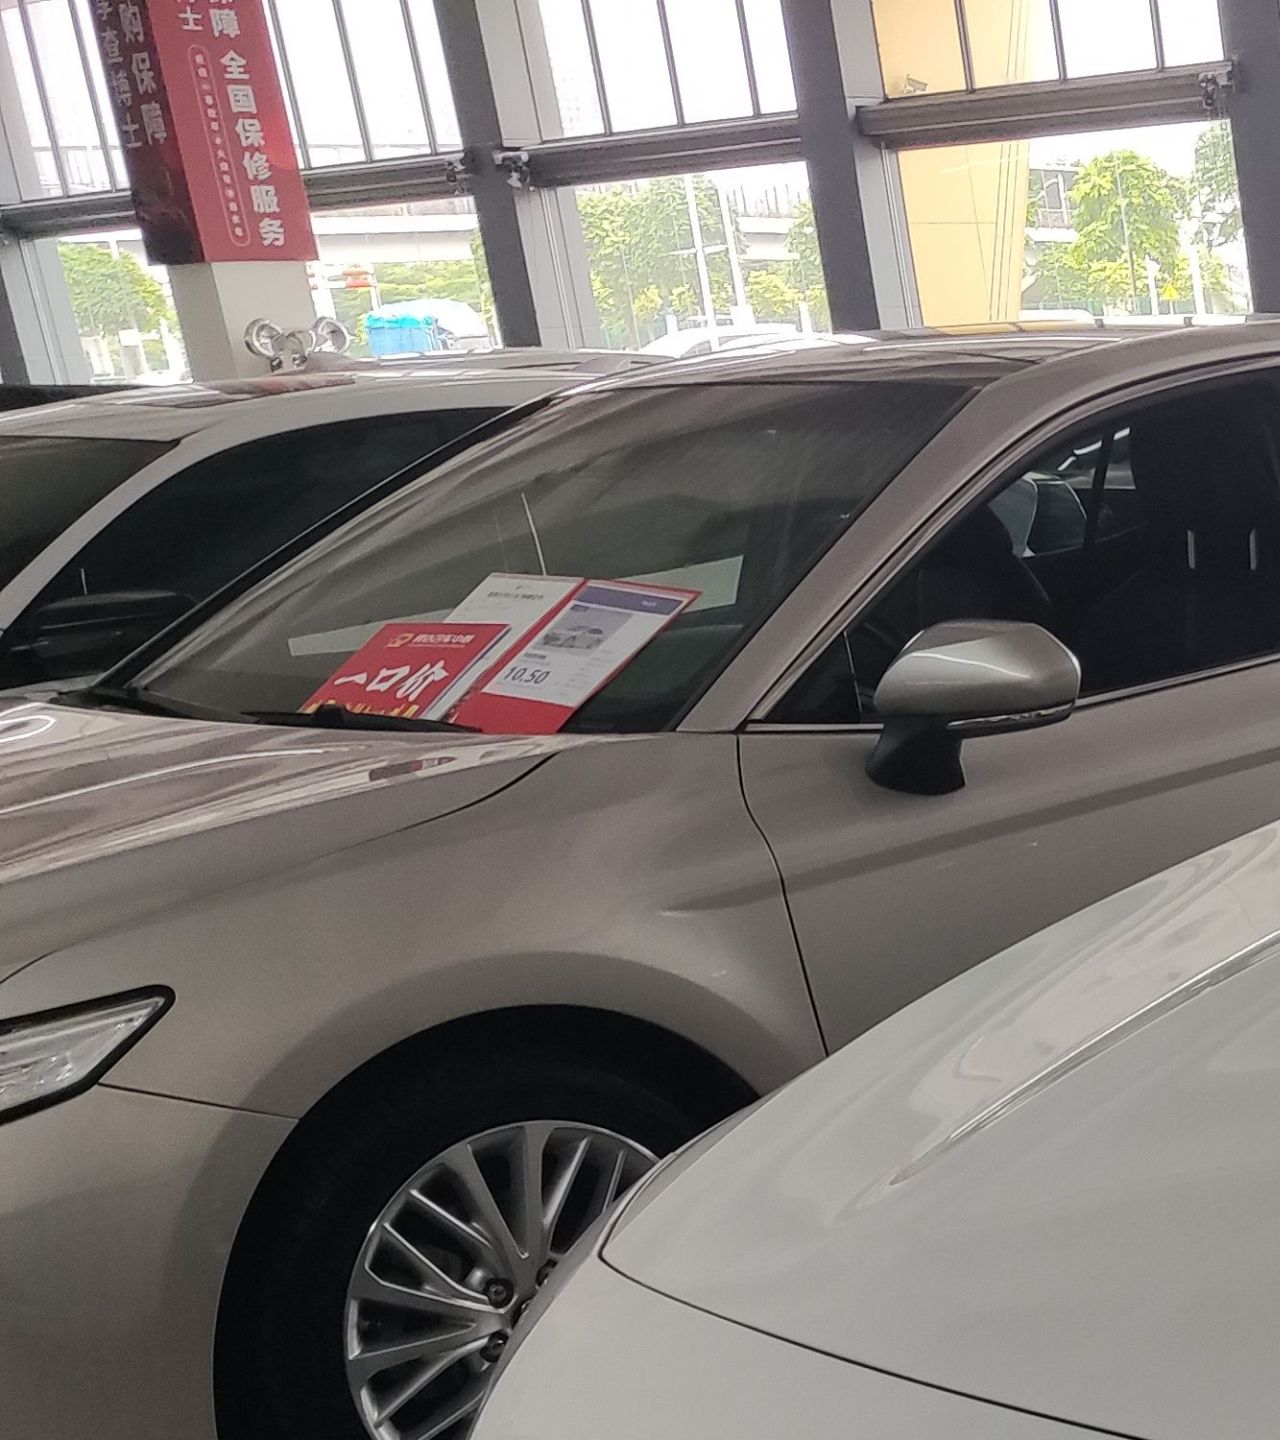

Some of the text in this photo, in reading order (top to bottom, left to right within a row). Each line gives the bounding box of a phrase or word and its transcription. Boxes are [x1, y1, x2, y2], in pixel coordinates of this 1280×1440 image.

[334, 660, 449, 701] 一口价
[504, 666, 551, 684] 10.50
